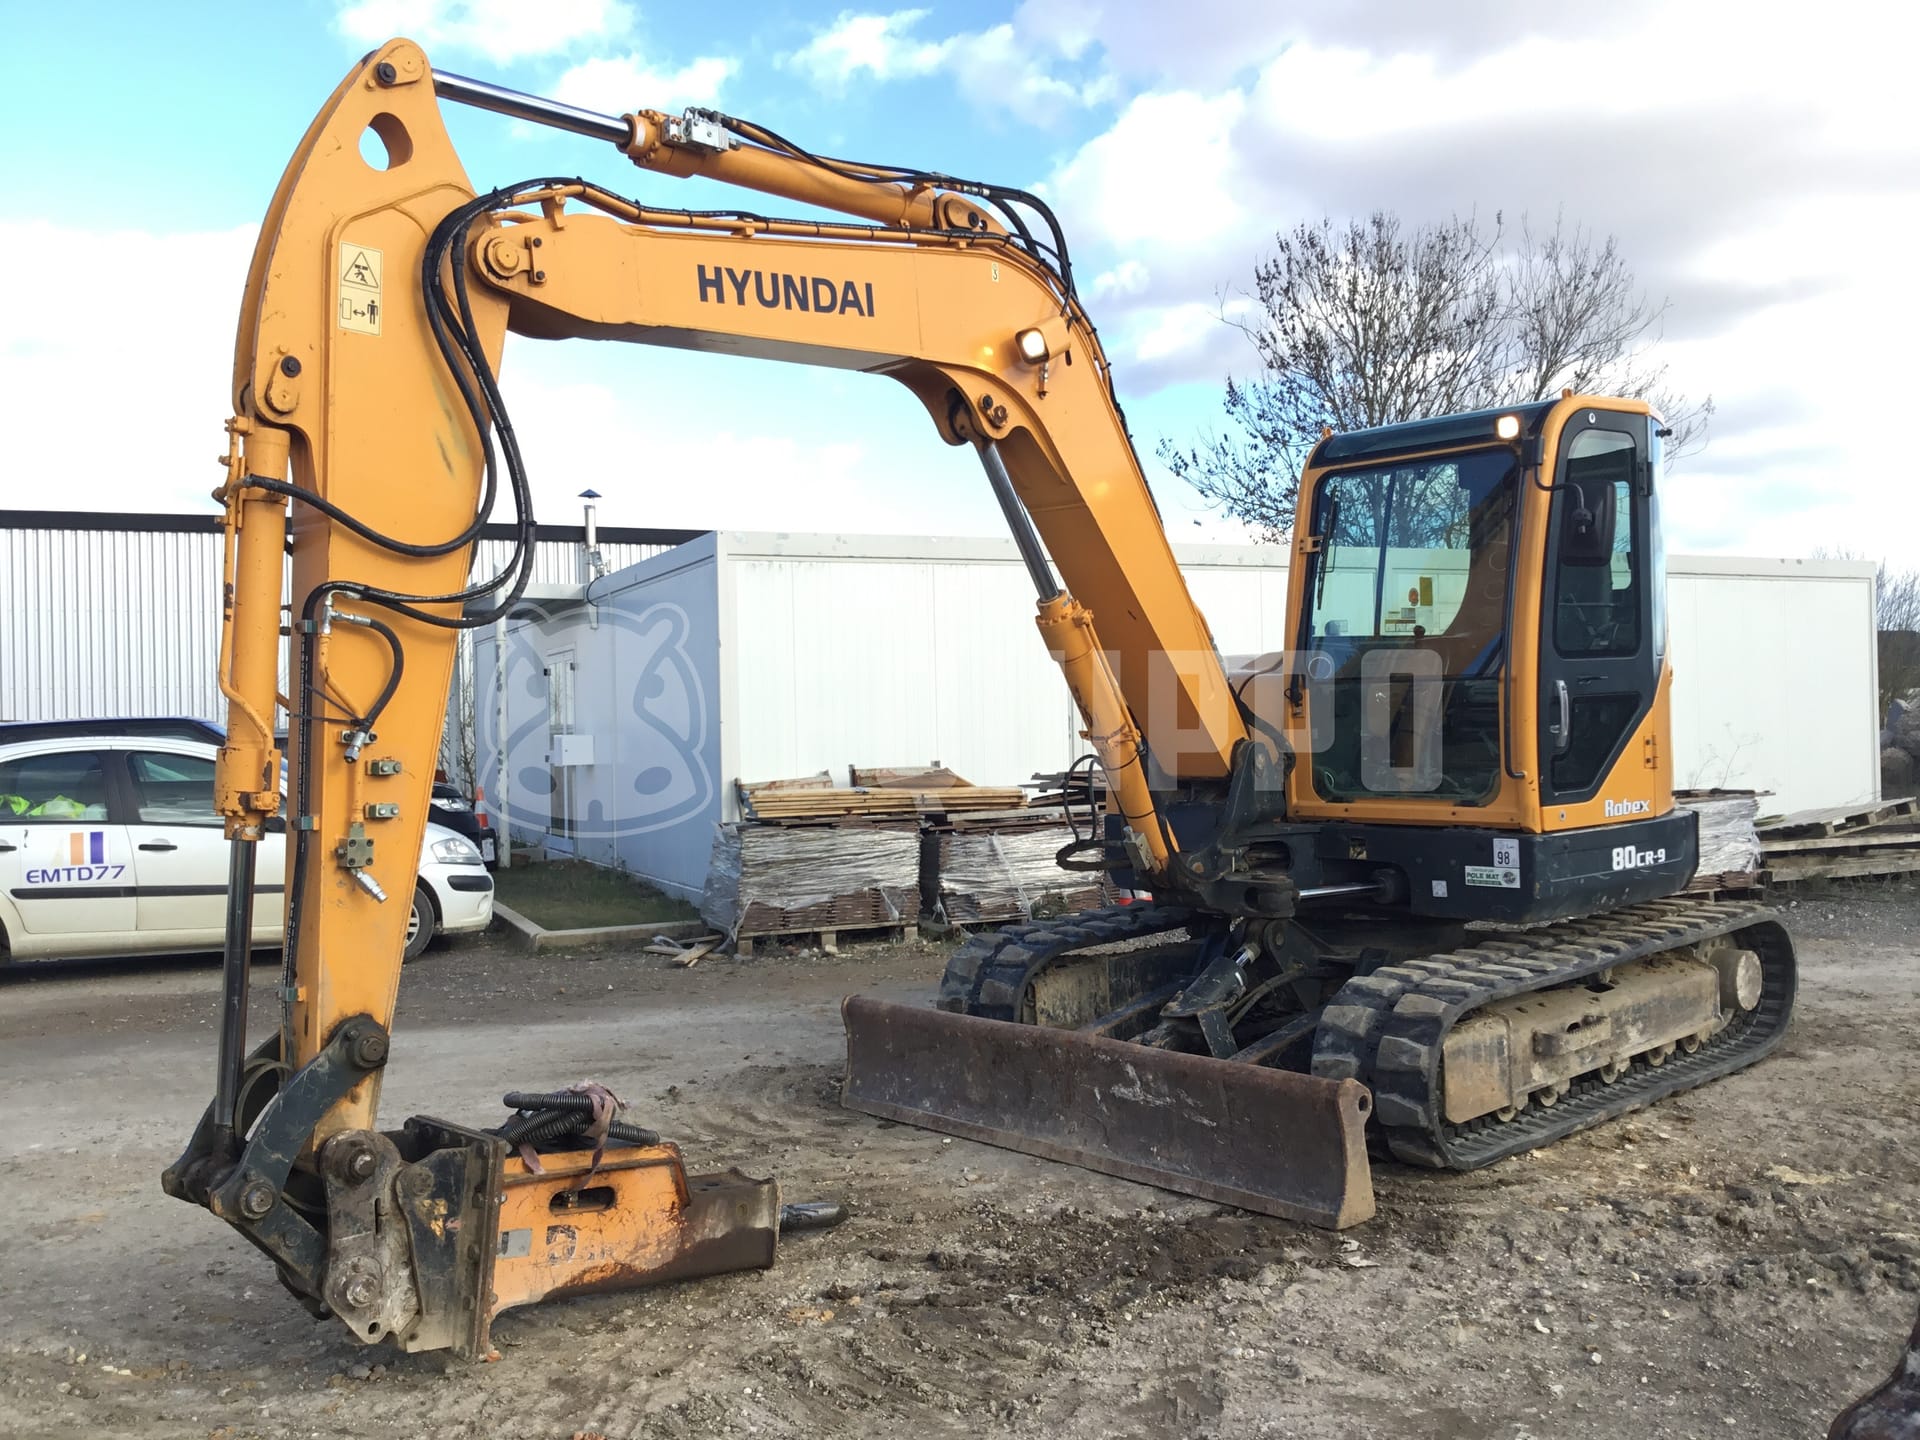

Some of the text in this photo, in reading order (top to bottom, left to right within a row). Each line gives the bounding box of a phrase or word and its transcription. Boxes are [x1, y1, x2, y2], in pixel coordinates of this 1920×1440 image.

[697, 264, 875, 318] HYUNDAI
[1604, 799, 1650, 818] Robex
[1497, 851, 1510, 865] 98
[1612, 845, 1666, 871] 80CR-9
[26, 865, 126, 884] EMTD77
